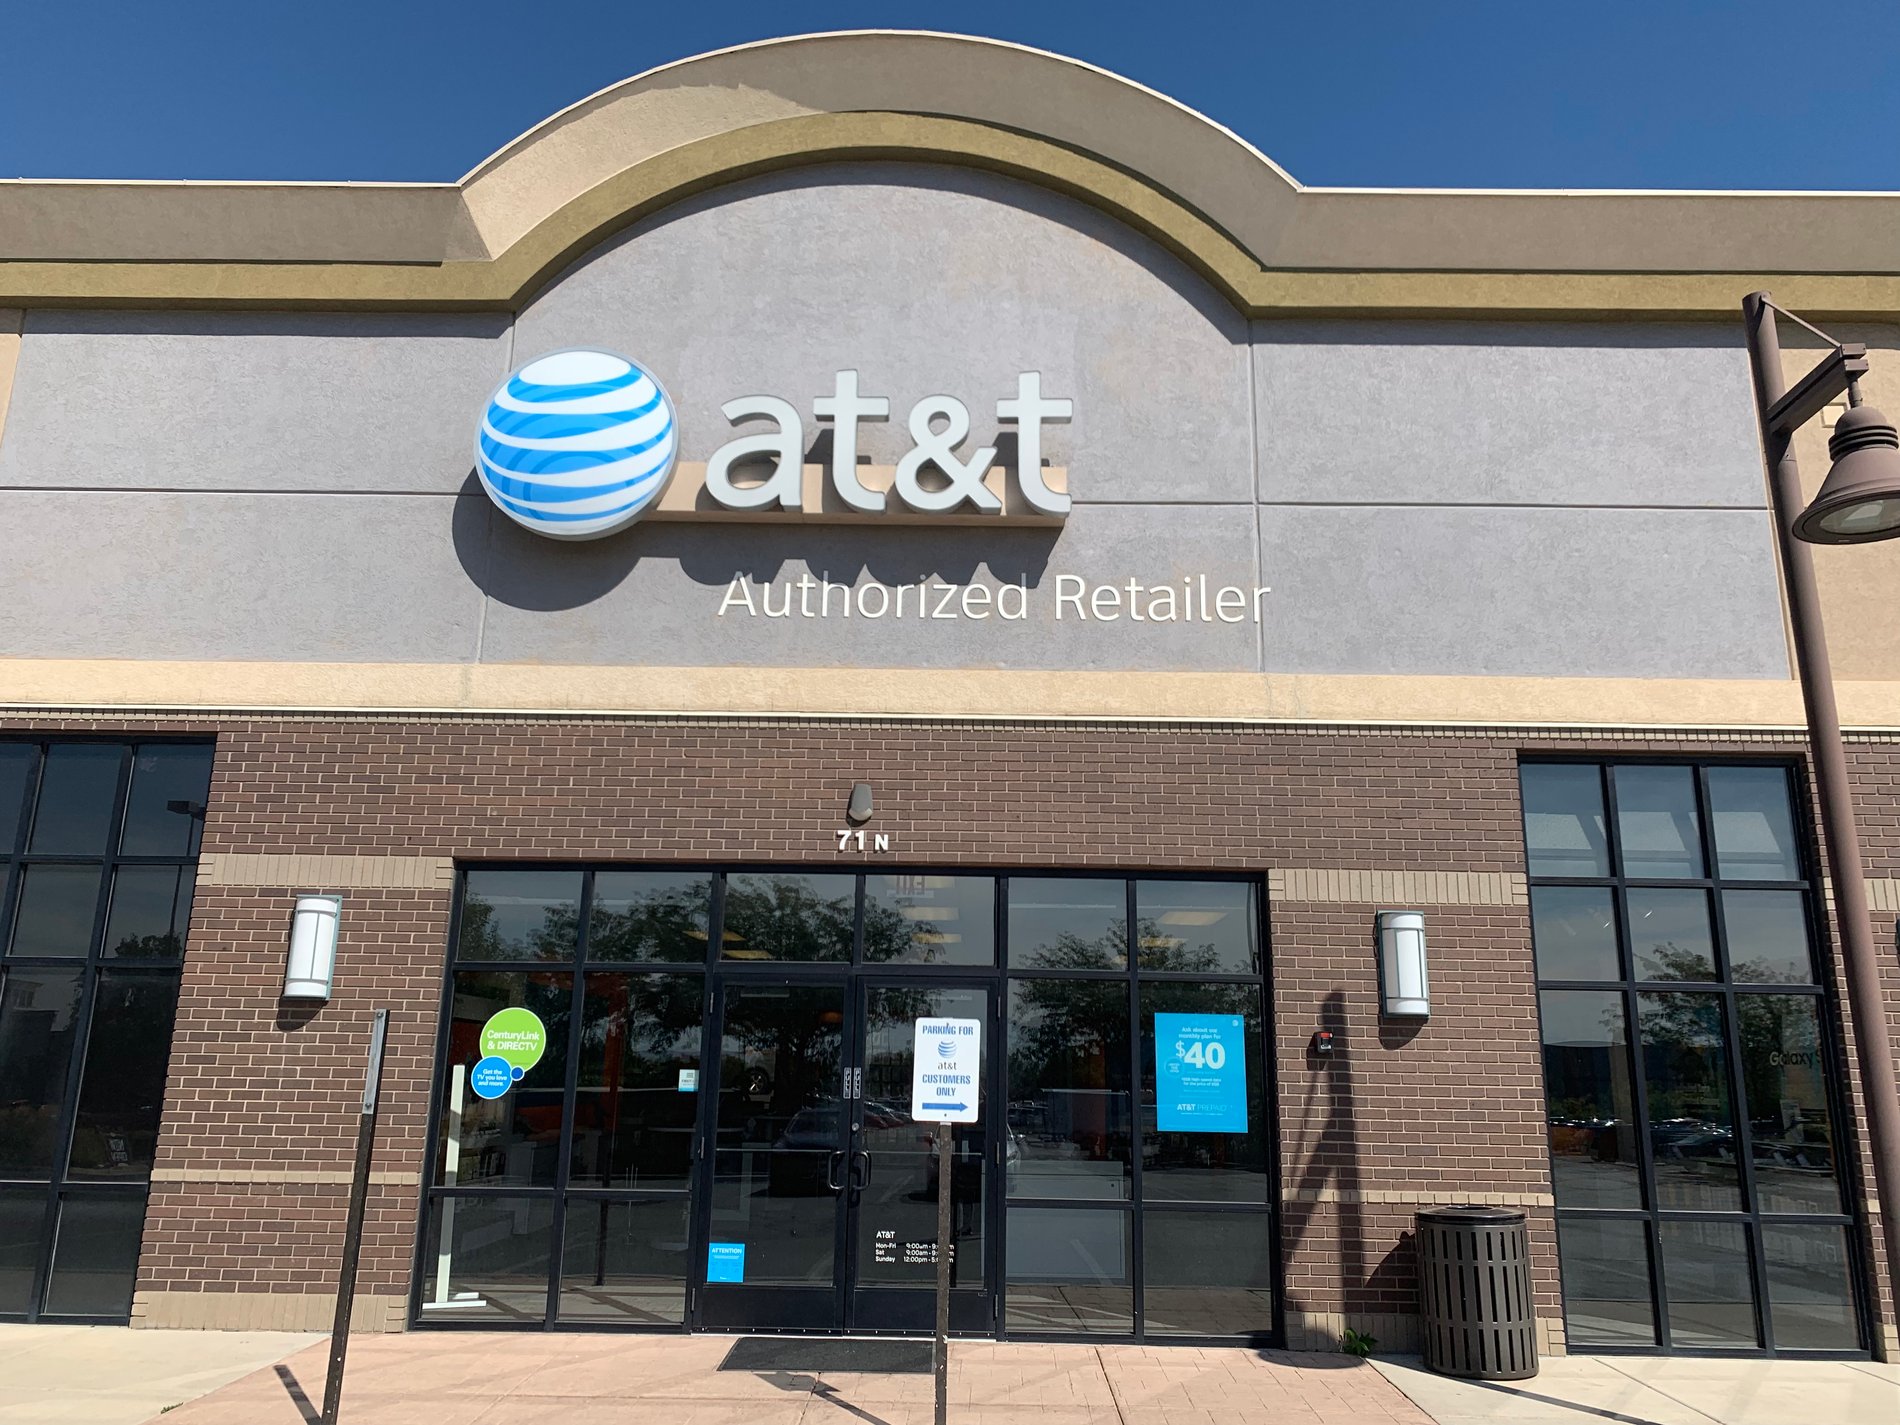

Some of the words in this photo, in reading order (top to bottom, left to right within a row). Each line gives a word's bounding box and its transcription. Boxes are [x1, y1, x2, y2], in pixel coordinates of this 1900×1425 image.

[705, 369, 1073, 516] at&t
[717, 570, 1028, 621] Authorized
[1054, 573, 1272, 624] Retailer
[837, 830, 864, 850] 71
[875, 834, 889, 850] N
[487, 1030, 540, 1041] CenturyLink
[922, 1025, 956, 1035] PARKING
[958, 1026, 974, 1035] FOR
[487, 1040, 495, 1050] &
[497, 1041, 538, 1051] DIRECTV
[1175, 1040, 1226, 1069] $40
[1769, 1051, 1813, 1069] Galaxy
[937, 1061, 957, 1071] at&t
[922, 1074, 971, 1085] CUSTOMERS
[936, 1087, 956, 1097] ONLY
[1177, 1103, 1196, 1111] AT&T
[876, 1230, 896, 1239] AT&T
[903, 1256, 928, 1264] 12:00pm
